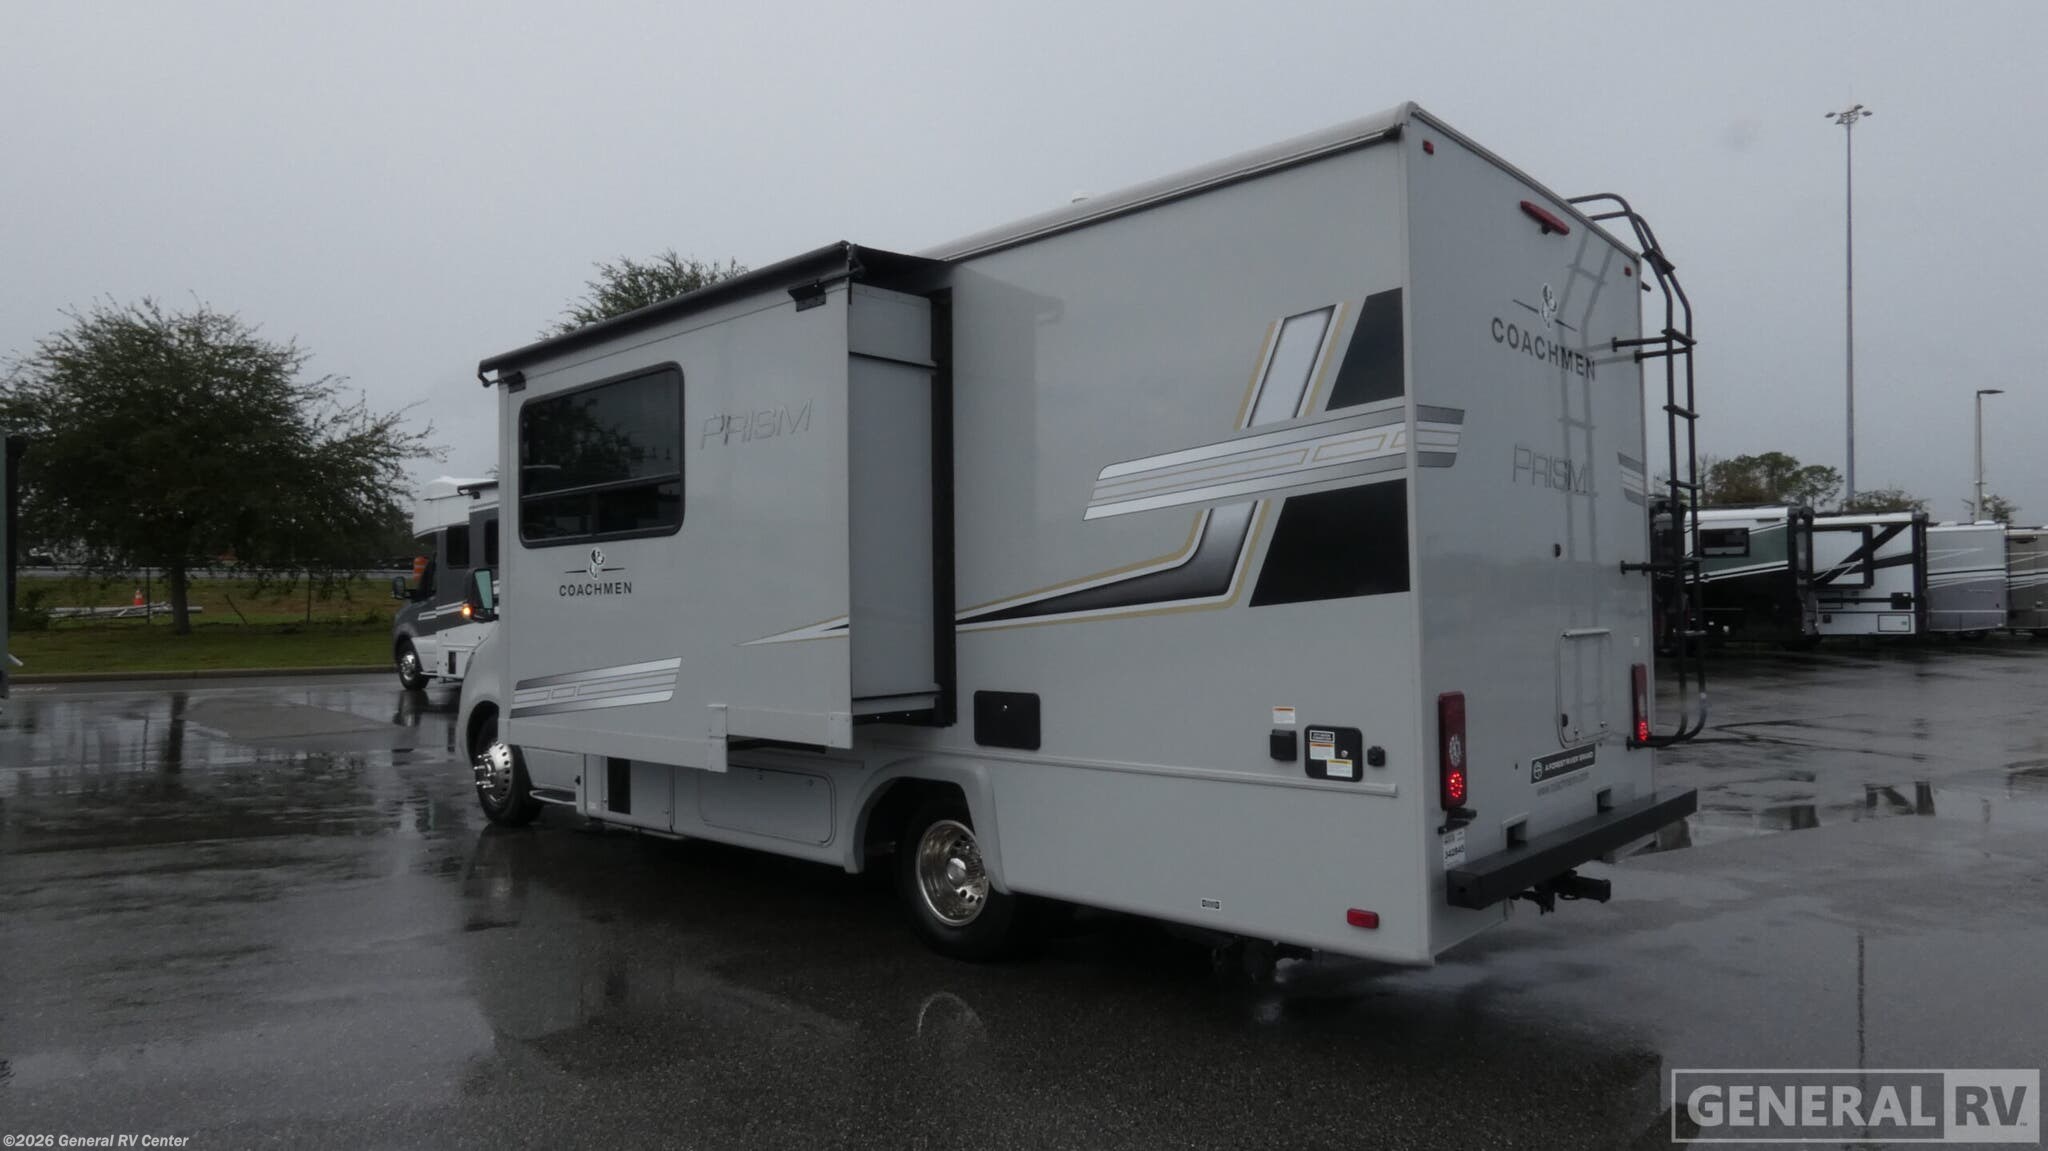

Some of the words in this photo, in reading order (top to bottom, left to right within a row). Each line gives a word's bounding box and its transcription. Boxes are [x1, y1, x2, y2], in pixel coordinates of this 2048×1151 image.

[1491, 316, 1596, 381] COACHMEN
[699, 396, 815, 450] PRISM
[1512, 442, 1588, 495] PRISM
[559, 581, 632, 597] COACHMEN
